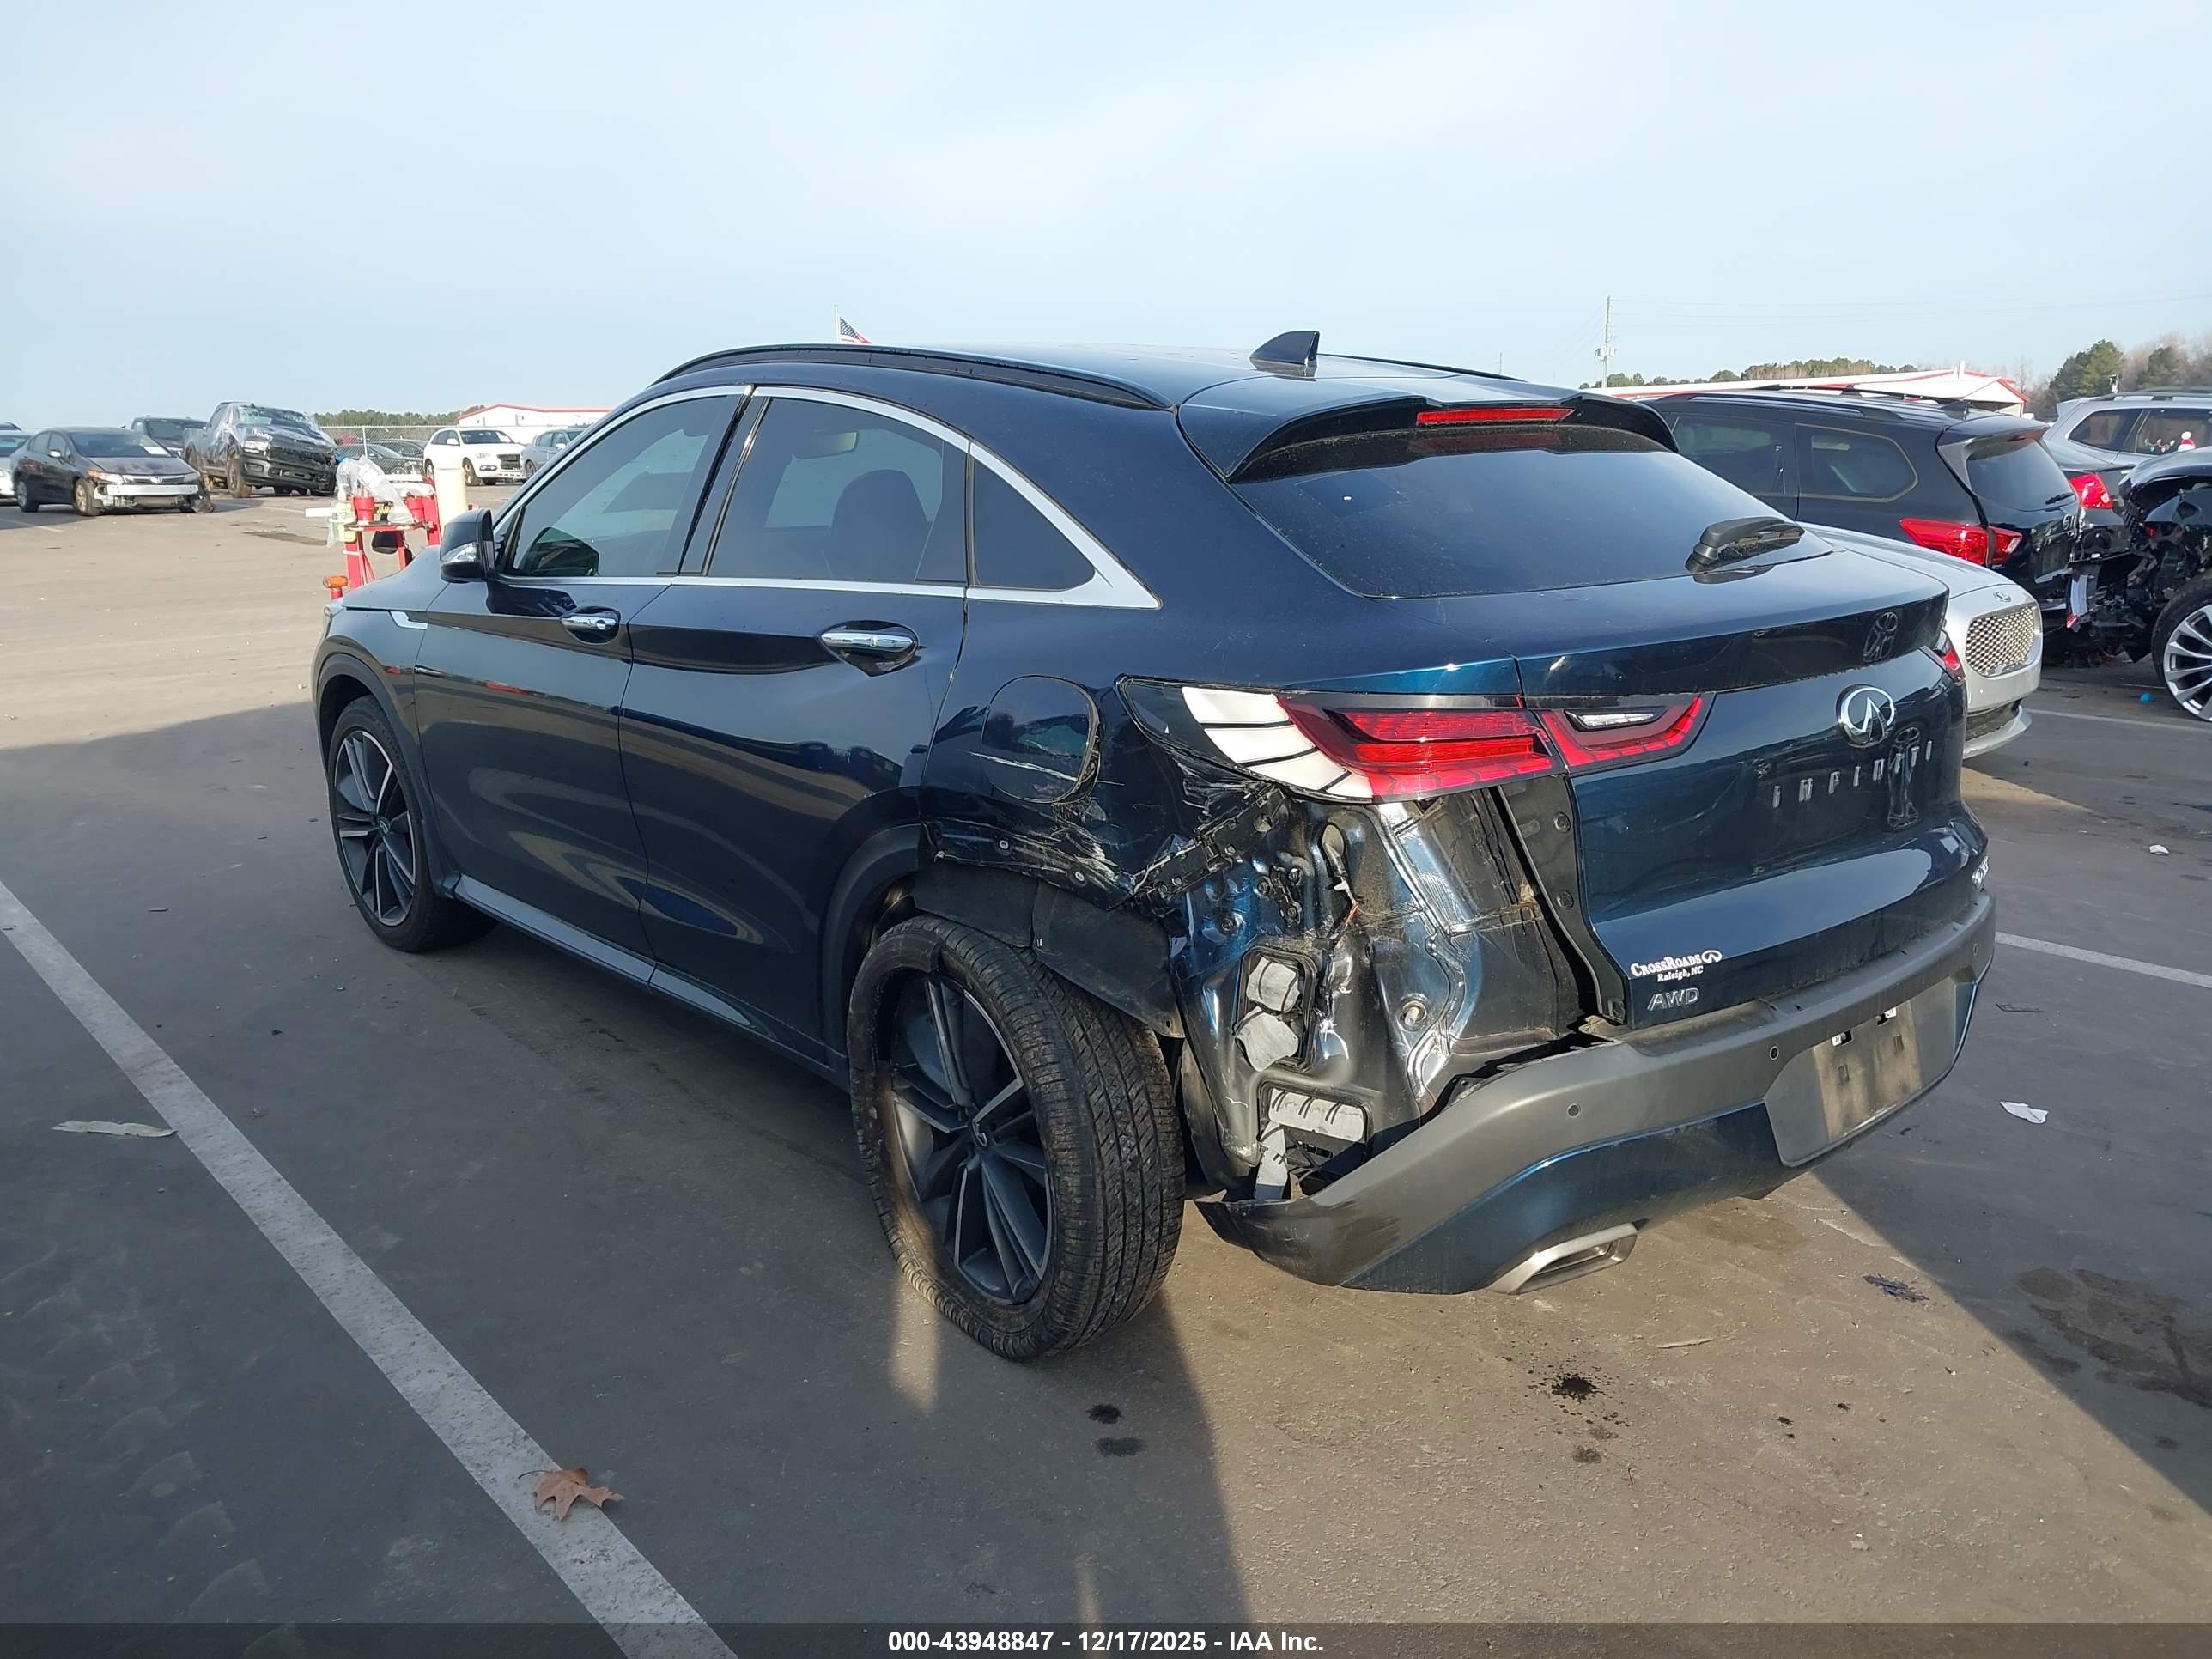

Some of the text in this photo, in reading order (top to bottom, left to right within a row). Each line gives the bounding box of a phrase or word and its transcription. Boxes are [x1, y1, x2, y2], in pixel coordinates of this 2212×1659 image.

[1657, 965, 1704, 982] Raleigh, NC
[1647, 988, 1699, 1011] AWD
